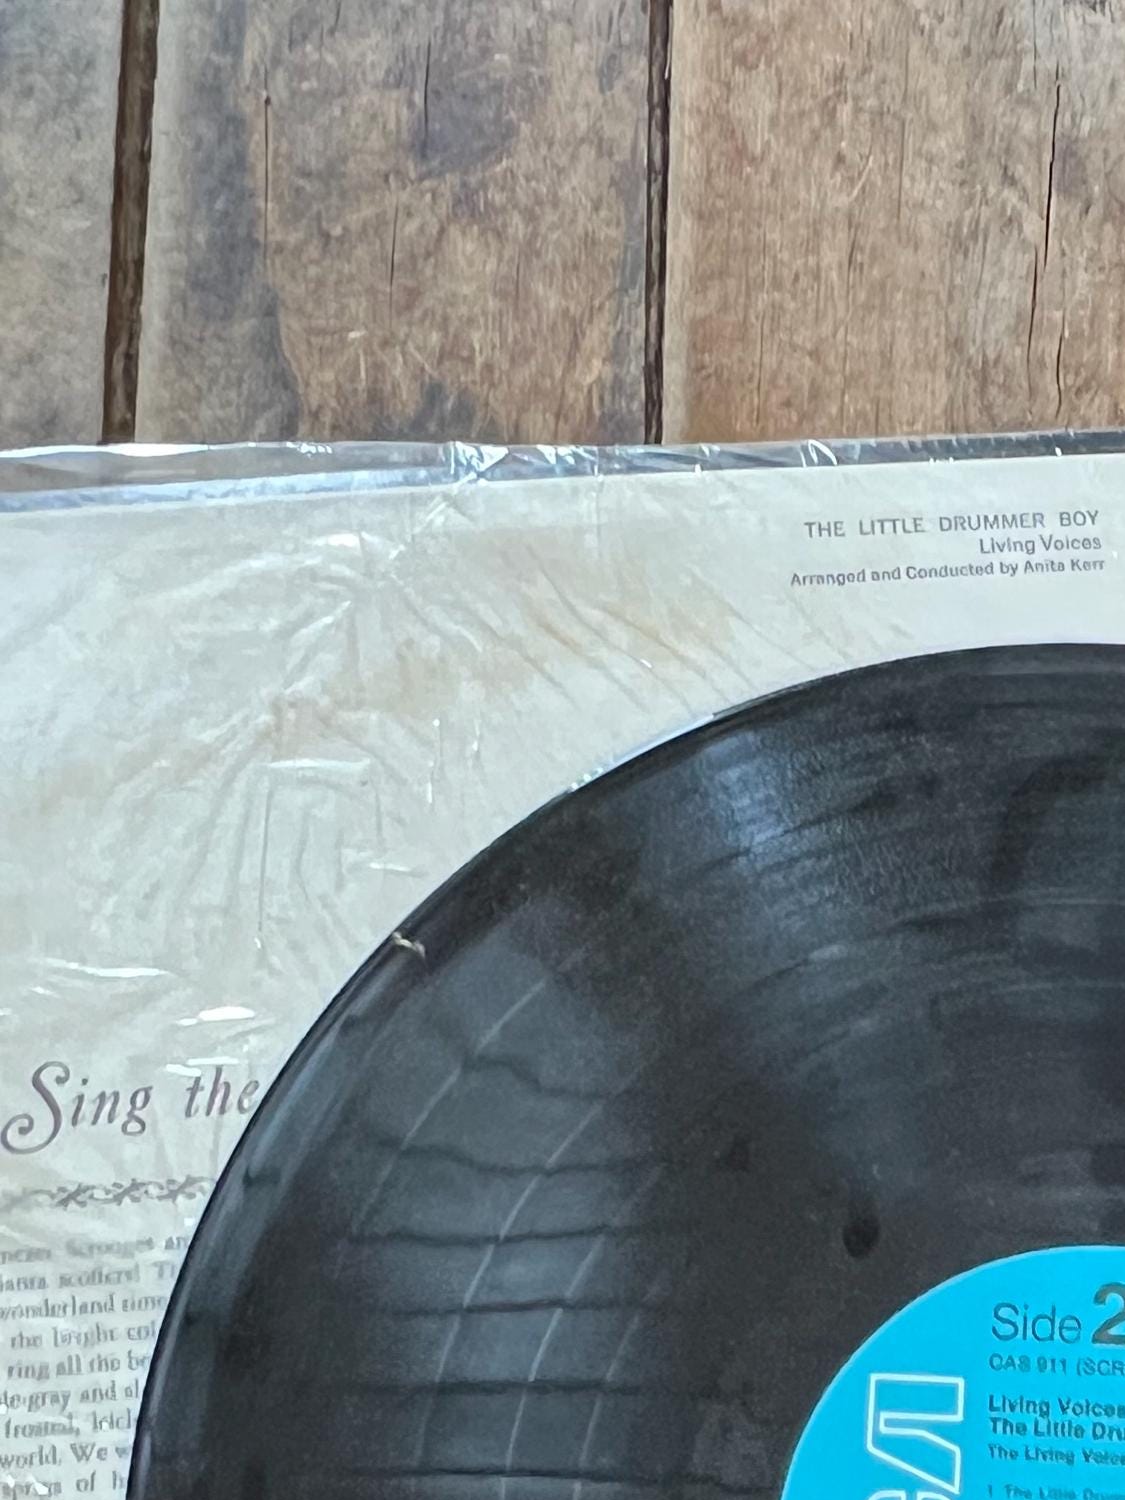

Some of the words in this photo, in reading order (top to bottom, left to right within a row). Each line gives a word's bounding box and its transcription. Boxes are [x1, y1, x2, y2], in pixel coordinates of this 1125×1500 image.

[804, 521, 846, 538] THE
[859, 517, 926, 536] LITTLE
[939, 512, 1046, 532] DRUMMER
[1059, 509, 1100, 528] BOY
[979, 537, 1036, 555] Living
[1042, 533, 1103, 551] Voices
[790, 572, 866, 587] Arranged
[871, 565, 901, 582] and
[906, 561, 995, 580] Conducted
[999, 559, 1018, 576] by
[1023, 558, 1066, 574] Anita
[1070, 557, 1105, 572] Kerr
[1, 1061, 153, 1154] Sing
[184, 1064, 260, 1119] the
[991, 1302, 1082, 1344] Side
[56, 1353, 83, 1376] all
[1036, 1356, 1067, 1376] 911
[80, 1379, 117, 1402] and
[988, 1394, 1051, 1418] Living
[989, 1416, 1027, 1437] The
[1033, 1418, 1086, 1440] Little
[70, 1442, 108, 1464] We
[988, 1443, 1019, 1461] The
[1025, 1445, 1076, 1467] Living
[75, 1470, 97, 1493] of
